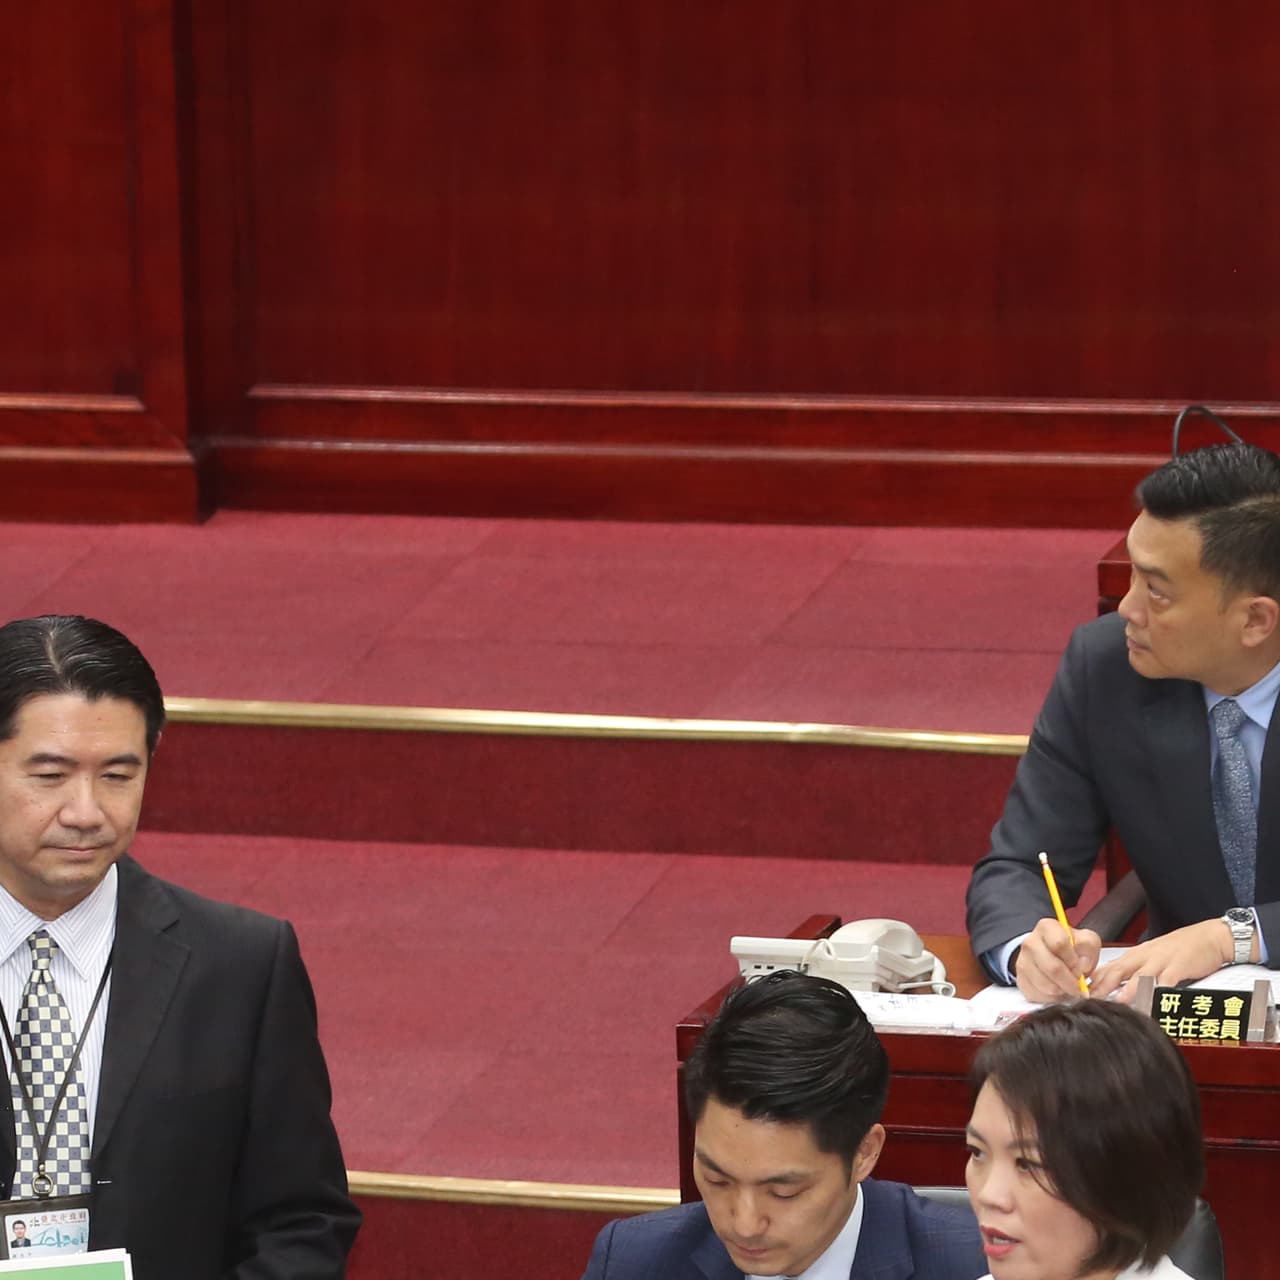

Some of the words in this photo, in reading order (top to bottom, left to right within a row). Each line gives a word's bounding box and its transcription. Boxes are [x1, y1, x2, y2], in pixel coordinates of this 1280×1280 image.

[1160, 993, 1245, 1017] 研考會
[1159, 1015, 1241, 1041] 主任委員
